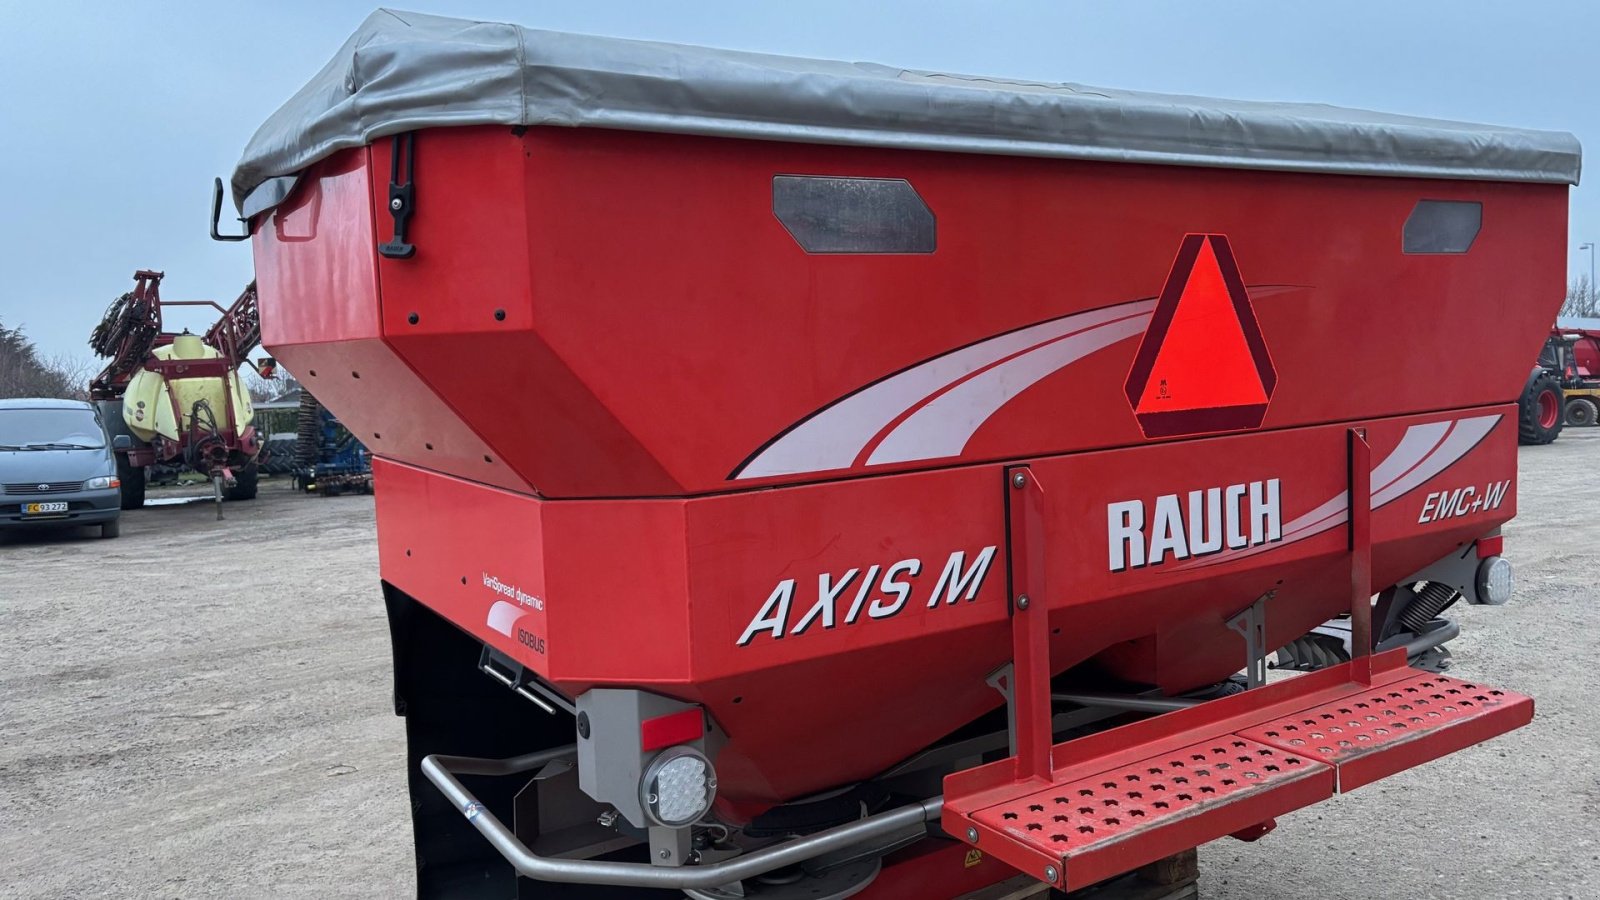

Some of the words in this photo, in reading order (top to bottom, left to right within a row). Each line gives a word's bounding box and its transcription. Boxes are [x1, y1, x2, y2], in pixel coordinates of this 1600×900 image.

[40, 503, 50, 511] 93
[1418, 480, 1511, 524] EMC+W
[1107, 478, 1283, 573] RAUCH
[482, 571, 515, 598] VariSpread
[516, 587, 543, 611] dynamic
[736, 558, 921, 648] AXIS
[927, 545, 998, 609] M
[518, 628, 545, 654] ISOBUS
